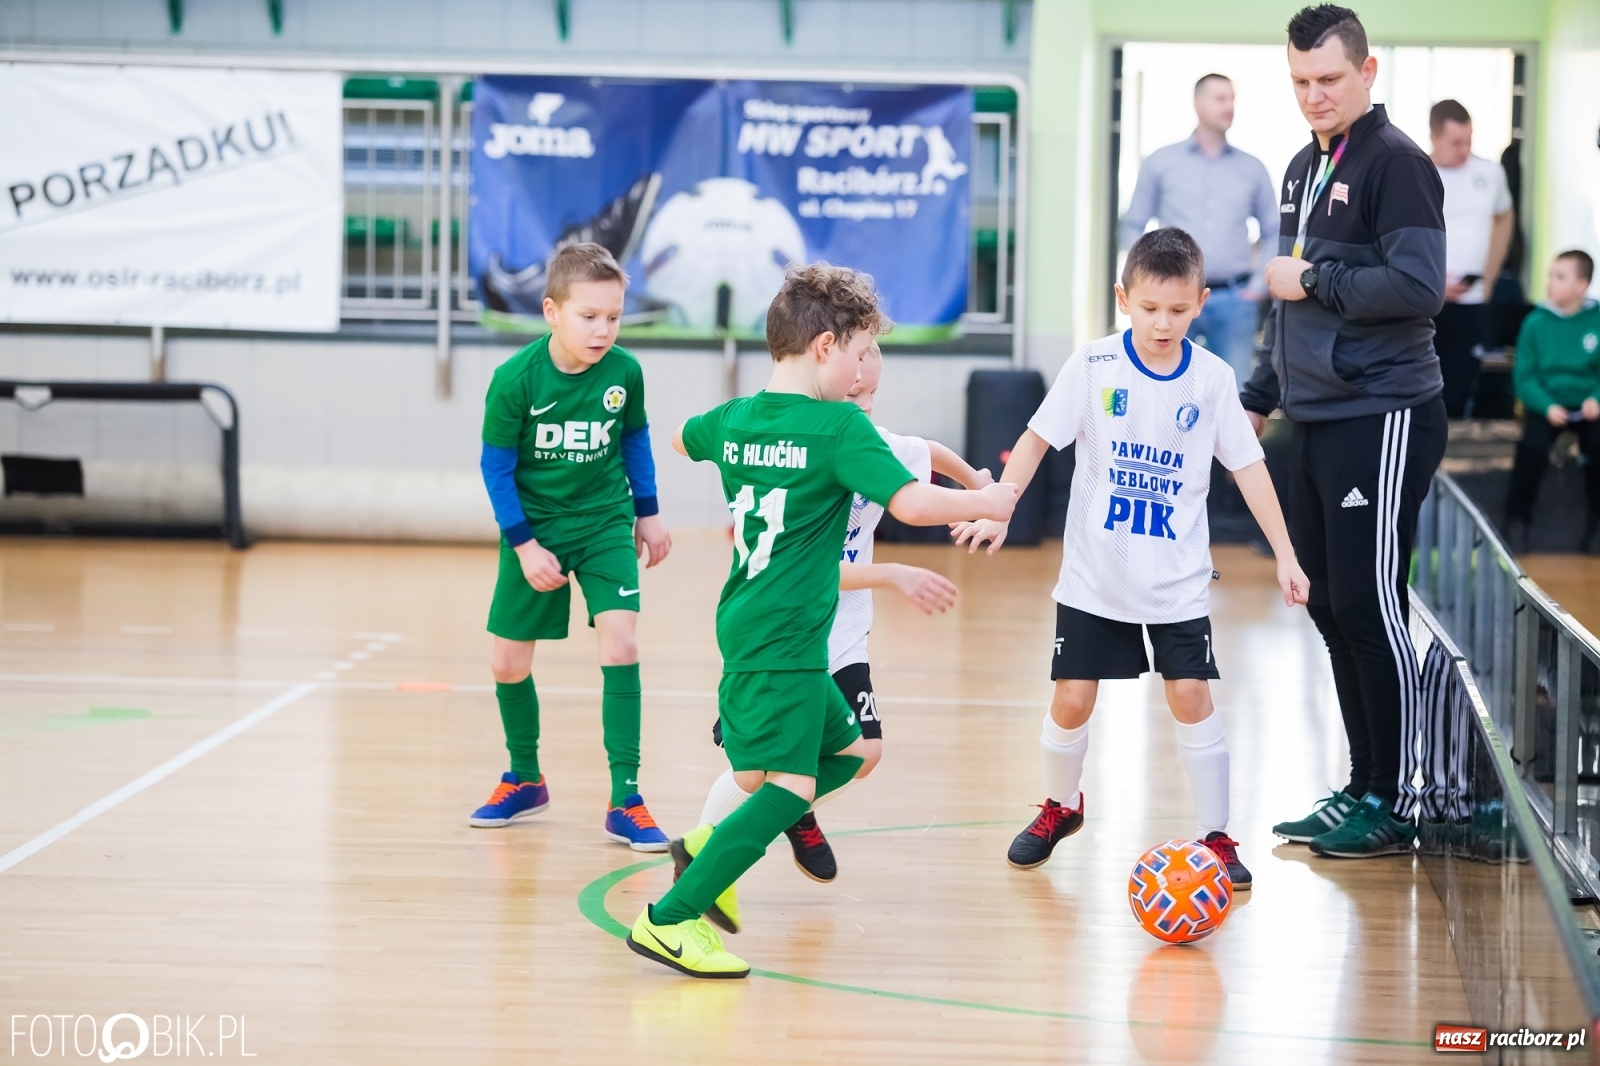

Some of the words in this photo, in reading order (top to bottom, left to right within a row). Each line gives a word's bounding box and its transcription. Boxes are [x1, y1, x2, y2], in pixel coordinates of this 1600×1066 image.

[804, 125, 921, 158] SPORT
[8, 110, 296, 217] PORZĄDKU!
[535, 419, 616, 450] DEK
[534, 447, 609, 463] STAVEBNINY
[723, 441, 739, 465] FC
[742, 440, 808, 469] HLUČÍN
[728, 484, 789, 580] 11
[1103, 494, 1177, 540] PIK
[857, 691, 881, 722] 20
